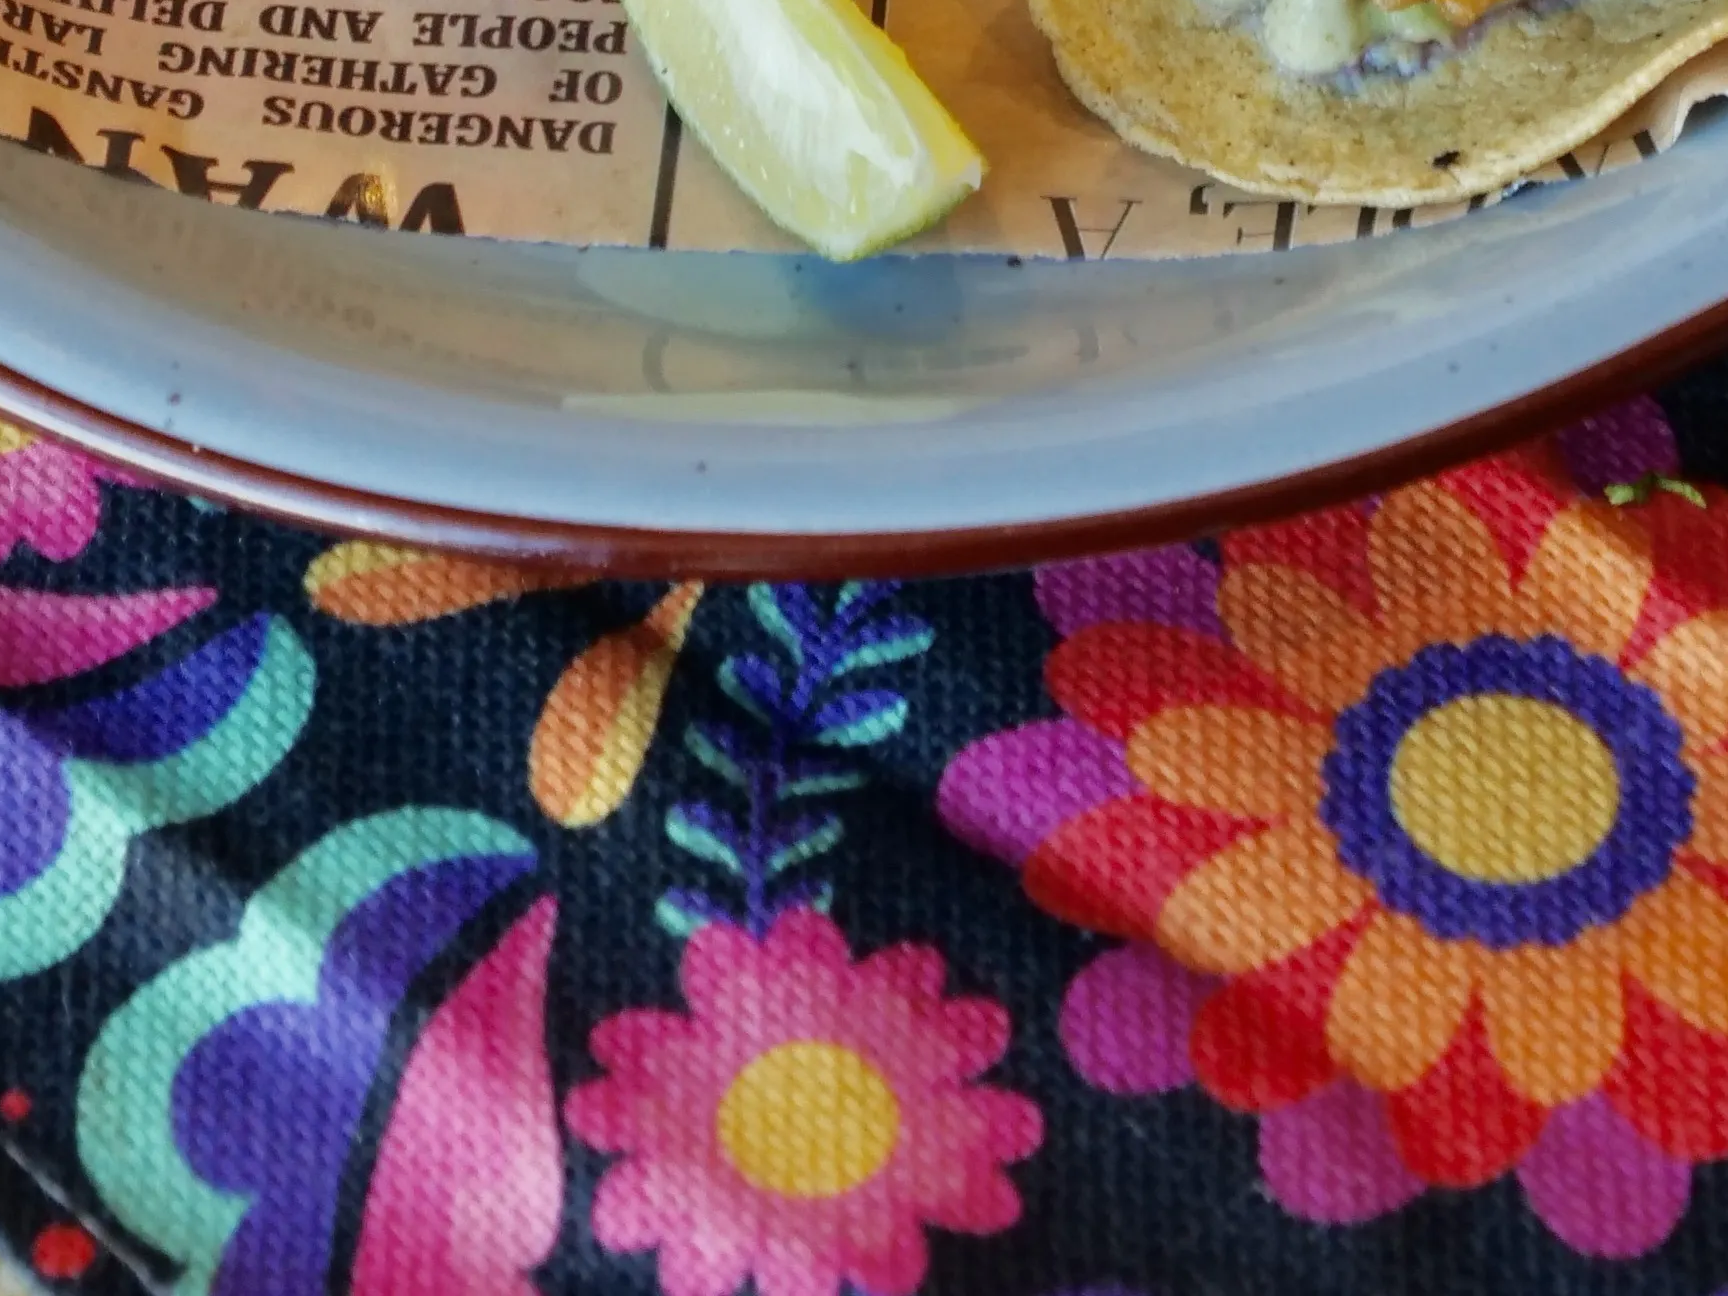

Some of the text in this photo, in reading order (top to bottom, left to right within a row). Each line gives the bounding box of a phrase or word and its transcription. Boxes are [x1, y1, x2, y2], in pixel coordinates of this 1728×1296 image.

[259, 3, 383, 44] AND
[412, 11, 629, 54] PEOPLE
[157, 42, 498, 97] GATHERING
[549, 68, 623, 104] OF
[261, 97, 617, 154] DANGEROUS
